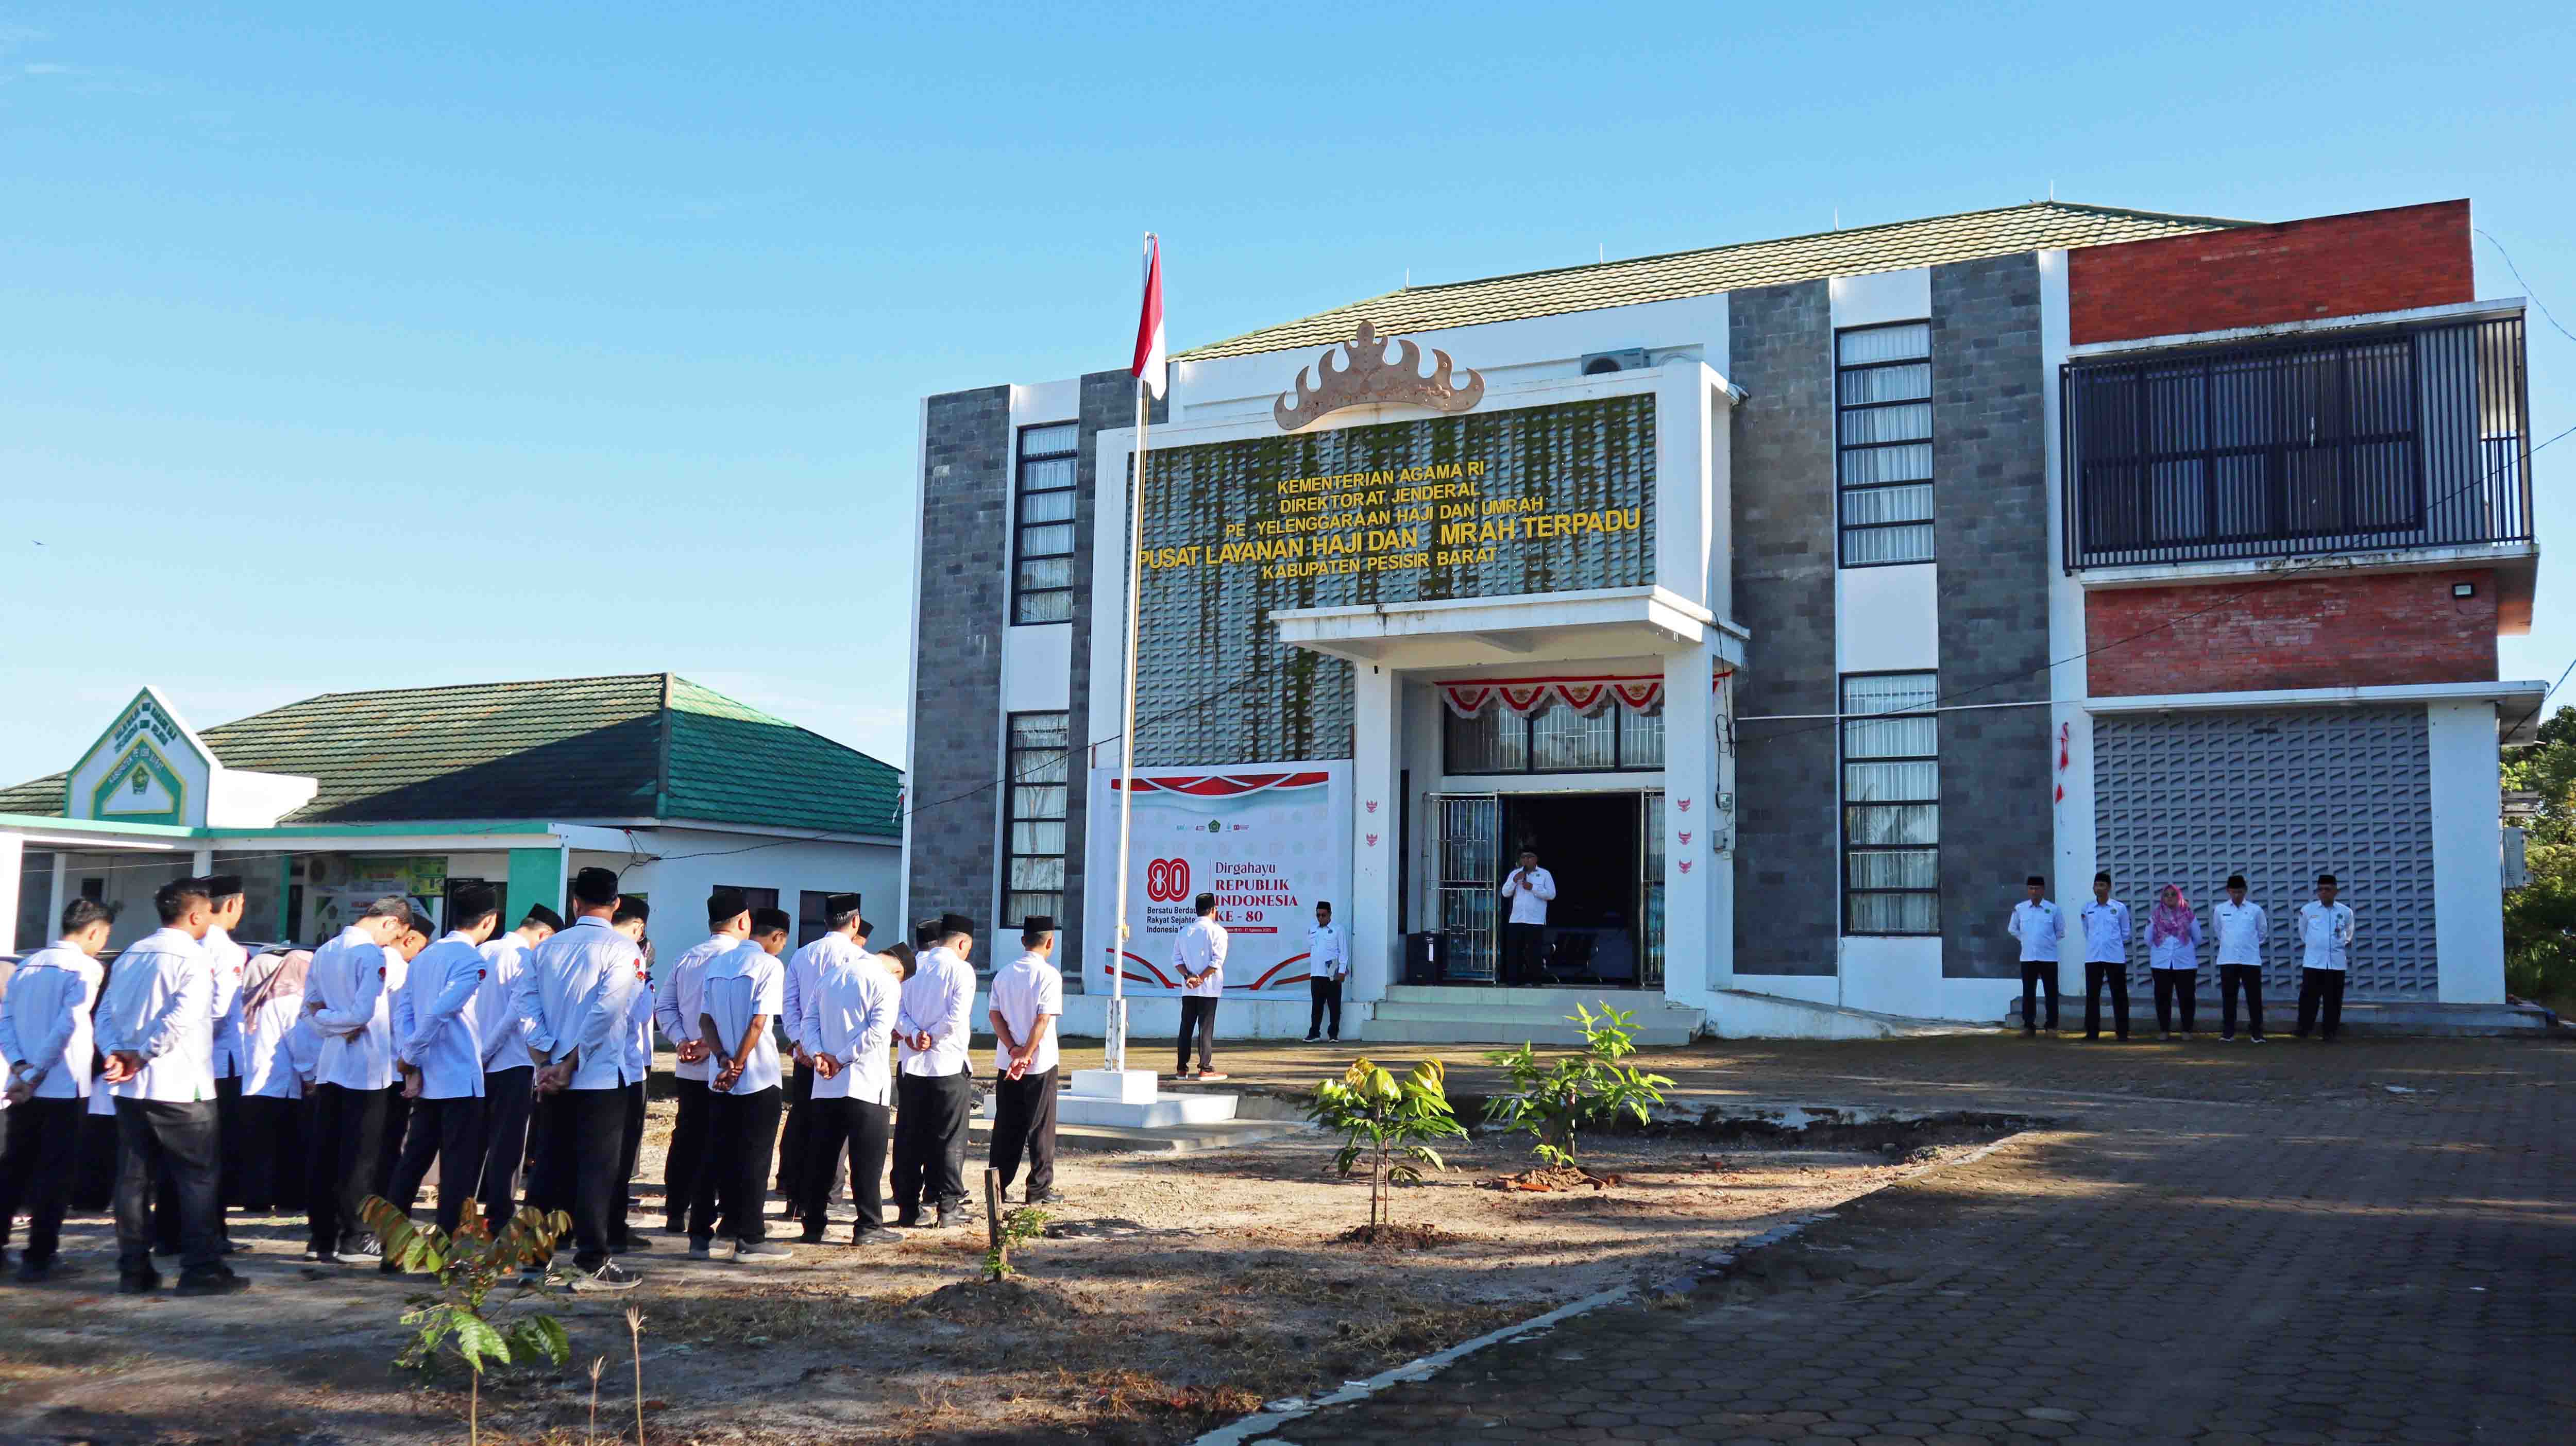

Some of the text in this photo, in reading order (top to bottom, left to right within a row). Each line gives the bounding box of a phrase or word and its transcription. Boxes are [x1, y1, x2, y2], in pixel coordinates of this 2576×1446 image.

[1278, 461, 1485, 495] KEMENTERIAN AGAMA RI
[1280, 482, 1480, 514] DIREKTORAT JENDERAL
[1397, 507, 1433, 522] HAJI
[1440, 503, 1476, 520] DAN
[1481, 497, 1544, 515] UMRAH
[1140, 545, 1201, 569] PUSAT
[1206, 537, 1304, 566] LAYANAN
[1312, 533, 1363, 556] HAJI
[1368, 528, 1418, 552] DAN
[1522, 508, 1641, 539] TERPADU
[1262, 548, 1497, 580] KABUPATEN PESISIR BARAT
[1147, 858, 1190, 903] 80
[1215, 862, 1276, 876] Dirgahayu
[1215, 879, 1290, 891] REPUBLIK
[1215, 895, 1298, 907] INDONESIA
[1147, 916, 1195, 925] Rakyat Sejahte
[1215, 910, 1233, 922] KE
[1246, 910, 1263, 922] 80
